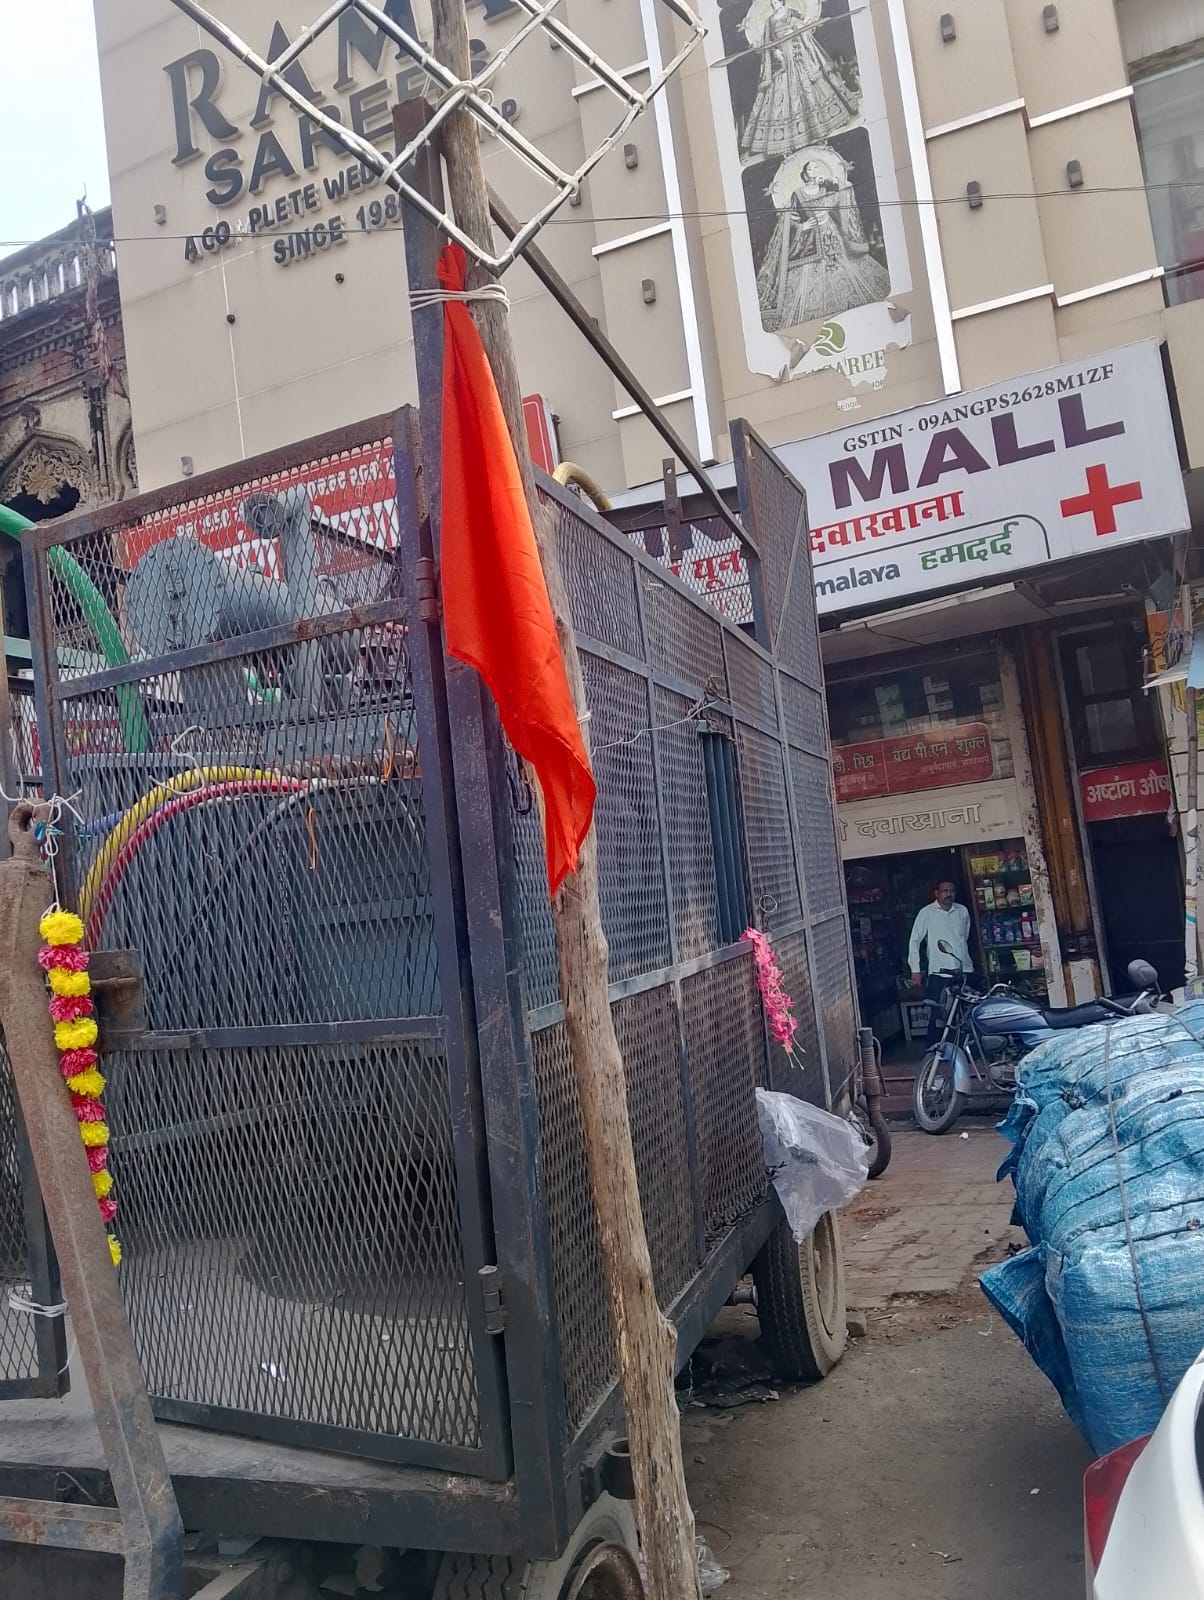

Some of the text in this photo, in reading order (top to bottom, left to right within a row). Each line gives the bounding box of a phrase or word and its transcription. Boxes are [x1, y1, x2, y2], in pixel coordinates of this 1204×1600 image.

[162, 0, 524, 166] RAM
[185, 235, 198, 262] A
[273, 193, 400, 266] SINCE 198
[843, 423, 904, 453] GSTIN
[918, 363, 1115, 432] 09ANGPS2628M1ZF
[828, 392, 1126, 510] MALL
[918, 521, 1020, 571] हमदर्द
[815, 562, 901, 598] malaya
[856, 802, 981, 838] दवाखाना
